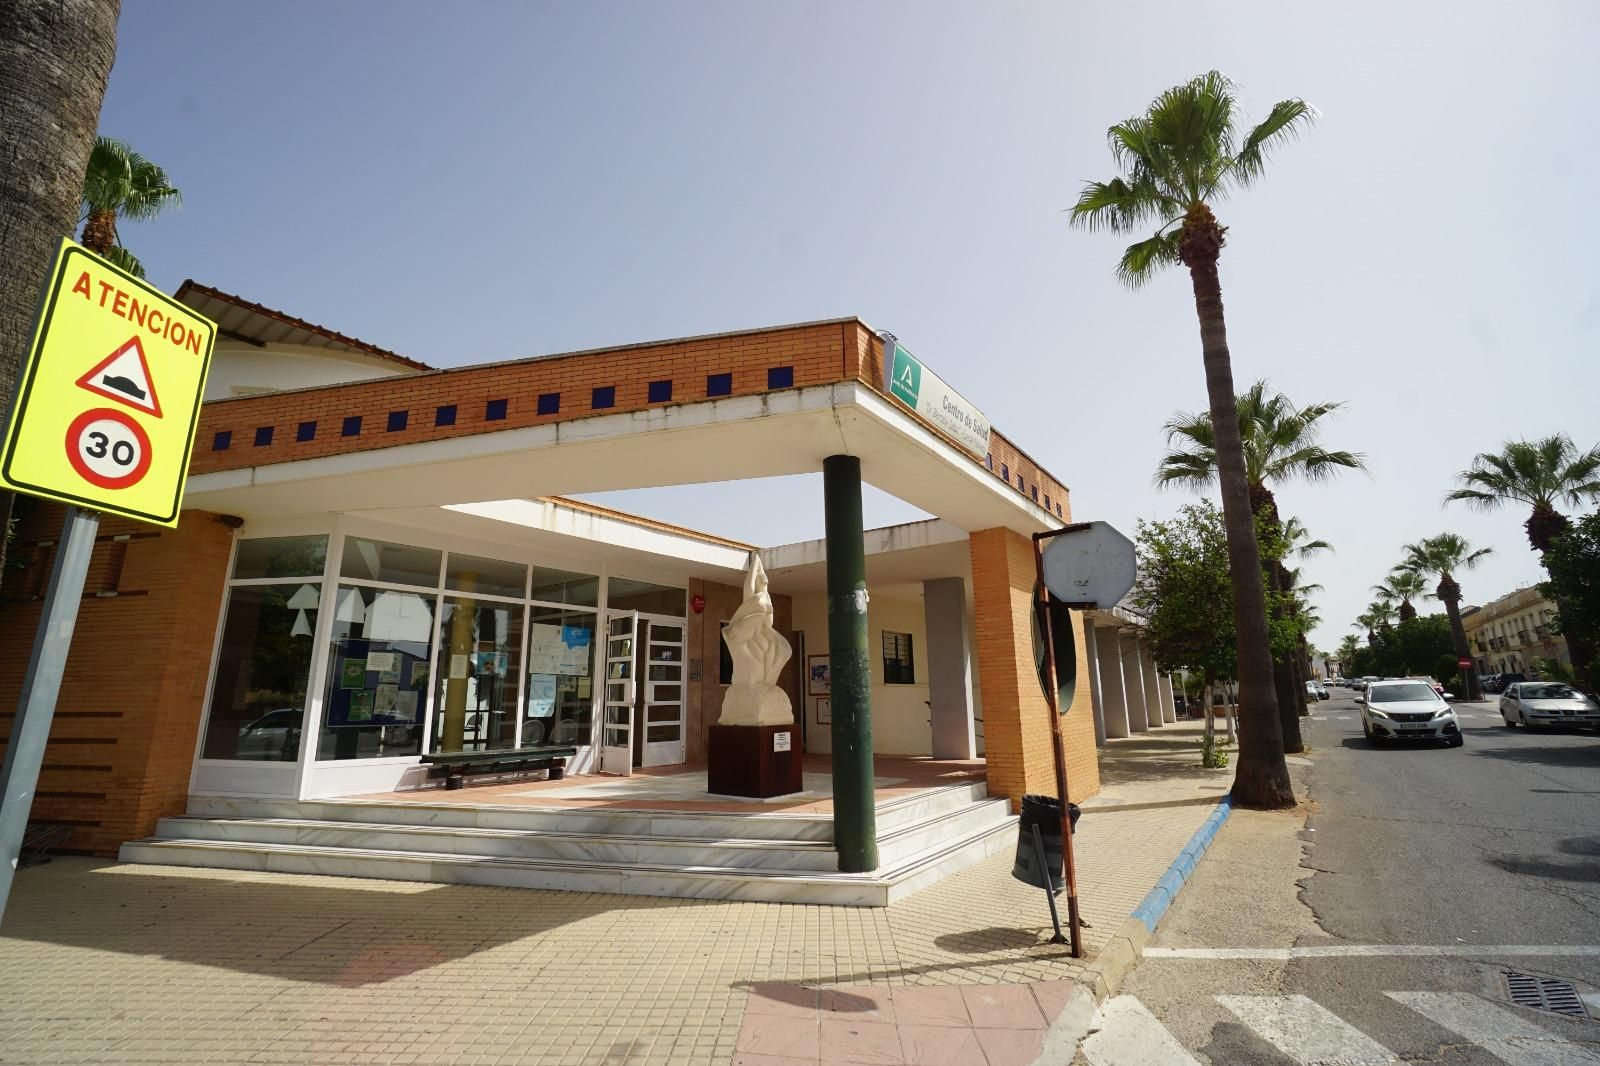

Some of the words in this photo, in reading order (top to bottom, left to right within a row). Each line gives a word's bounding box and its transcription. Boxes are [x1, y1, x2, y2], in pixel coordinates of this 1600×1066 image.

[72, 271, 202, 355] ATENCION
[942, 394, 964, 422] Centro
[965, 413, 972, 429] de
[973, 419, 989, 441] Salud
[85, 431, 135, 466] 30
